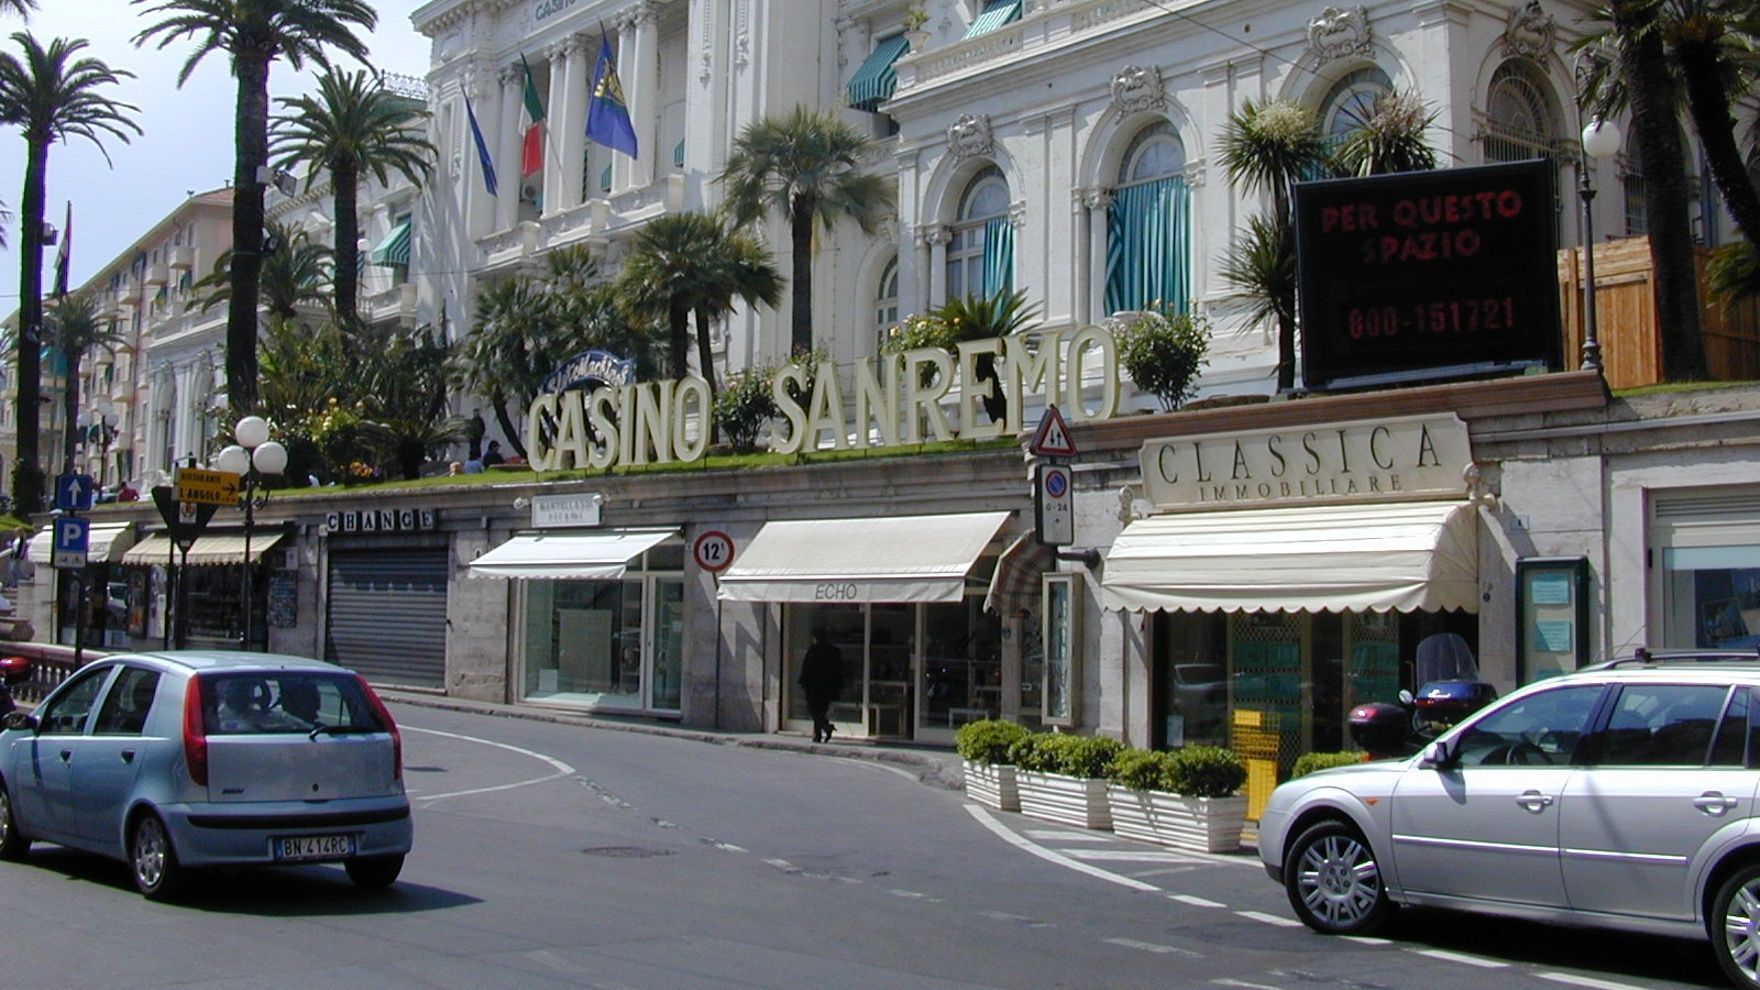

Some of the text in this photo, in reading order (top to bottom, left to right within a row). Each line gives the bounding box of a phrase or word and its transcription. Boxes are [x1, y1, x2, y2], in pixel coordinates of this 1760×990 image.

[1321, 190, 1522, 233] PER QUESTO
[1361, 229, 1480, 264] SPAZIO
[1350, 298, 1514, 339] 800-151721
[527, 325, 1123, 473] CASINO SANREMO
[1158, 423, 1442, 484] CLASSICA
[1200, 475, 1403, 502] IMMOBILIARE
[62, 523, 82, 547] P
[328, 511, 433, 530] CHANGE
[815, 584, 858, 600] ECHO
[284, 840, 302, 856] BN
